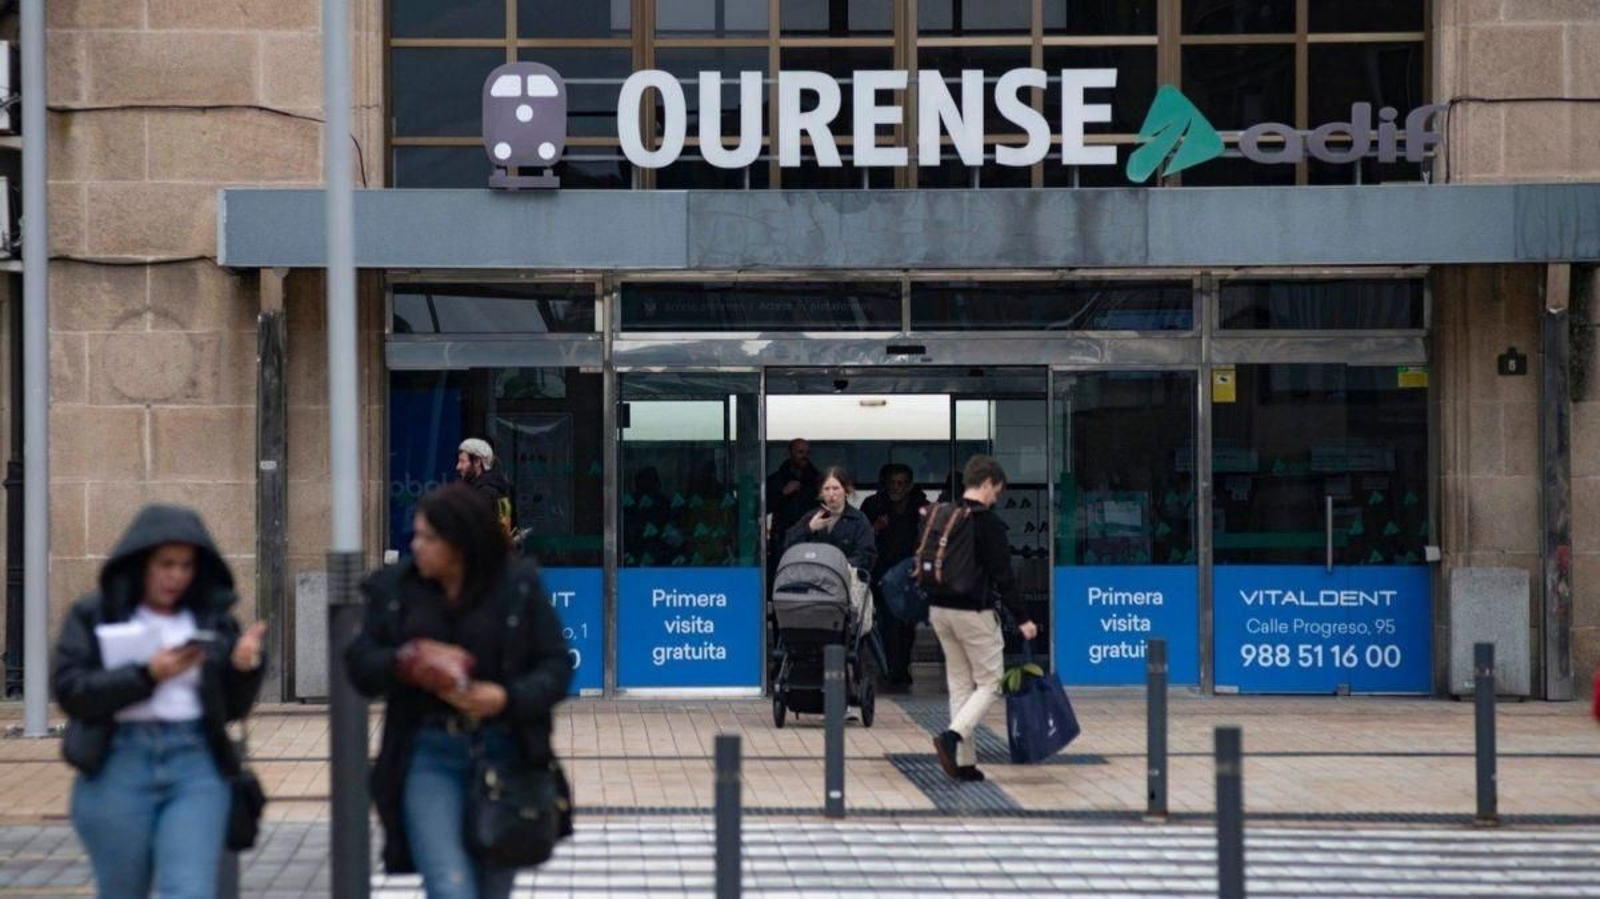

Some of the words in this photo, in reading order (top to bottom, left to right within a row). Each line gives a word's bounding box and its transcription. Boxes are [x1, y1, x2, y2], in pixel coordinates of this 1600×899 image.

[617, 67, 1117, 168] OURENSE
[1238, 102, 1448, 164] adif
[652, 588, 726, 607] Primera
[1088, 587, 1163, 606] Primera
[1239, 590, 1398, 606] VITALDENT
[664, 615, 715, 634] visita
[1100, 612, 1151, 632] visita
[1246, 618, 1288, 634] Calle
[1293, 618, 1371, 638] Progreso,
[1375, 619, 1396, 635] 95
[652, 641, 726, 666] gratuita
[1088, 639, 1148, 664] gratui
[1240, 644, 1291, 667] 988
[1298, 644, 1323, 667] 51
[1330, 645, 1358, 667] 16
[1364, 645, 1401, 668] 00
